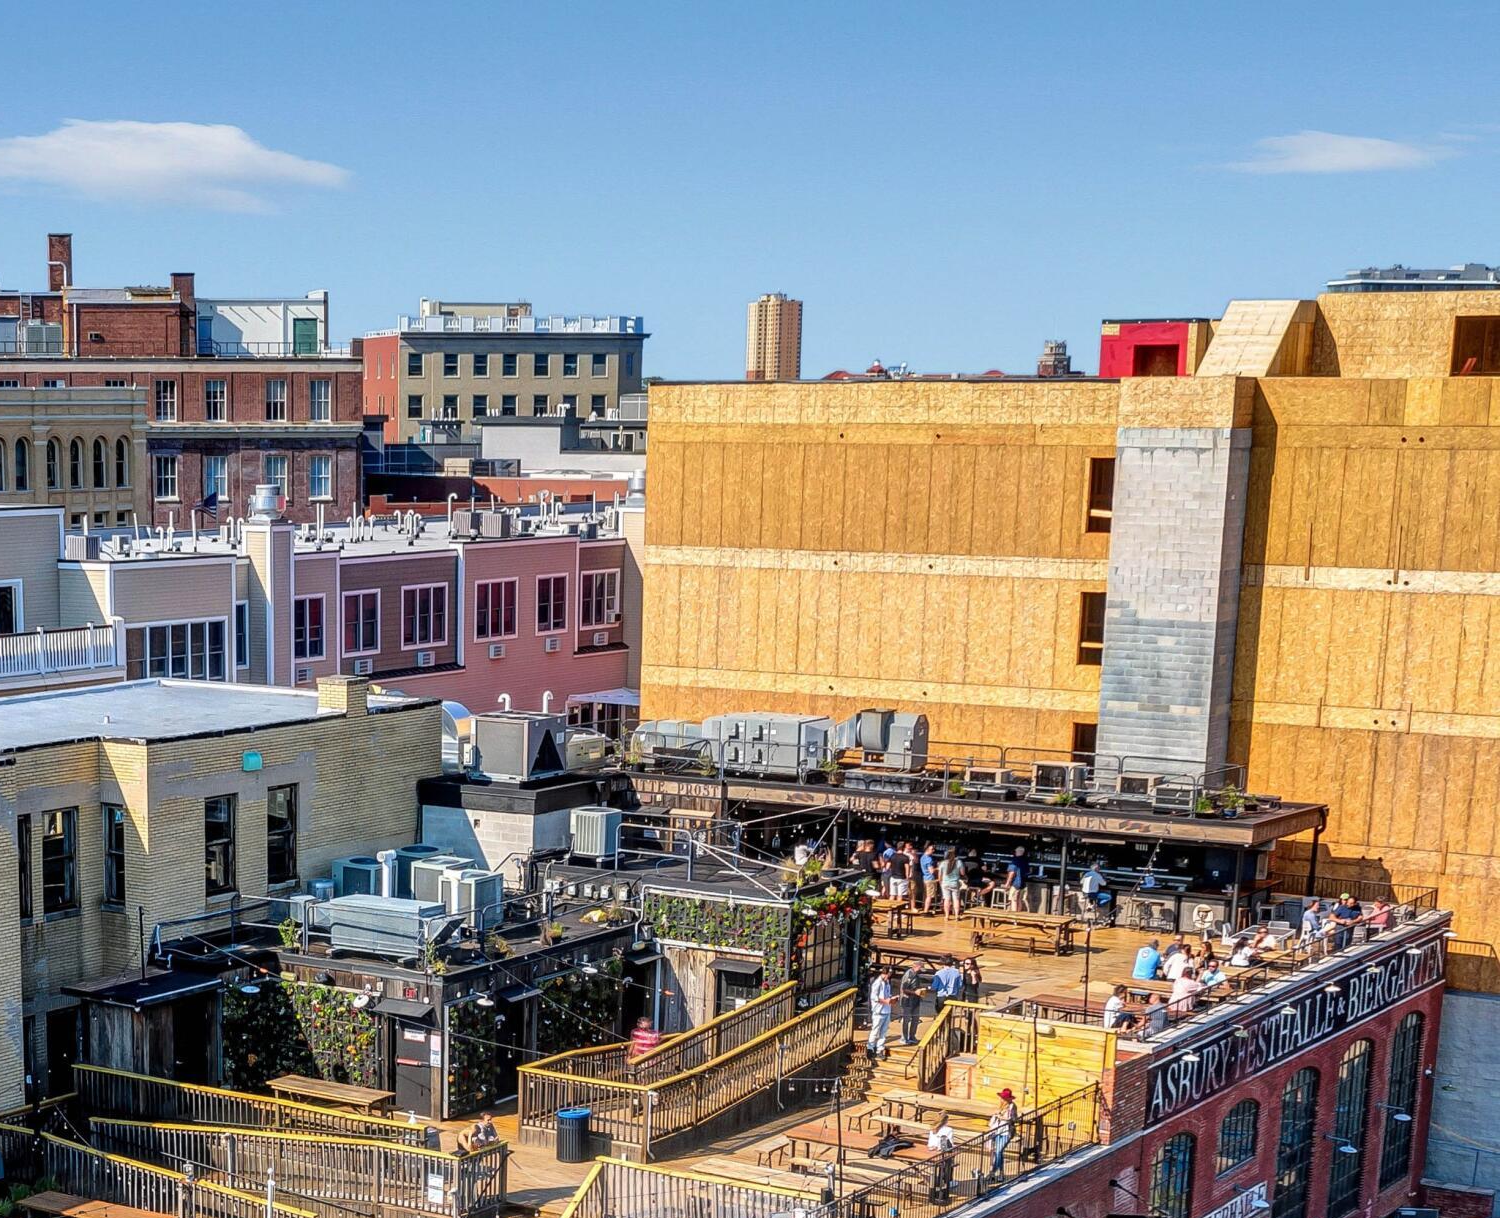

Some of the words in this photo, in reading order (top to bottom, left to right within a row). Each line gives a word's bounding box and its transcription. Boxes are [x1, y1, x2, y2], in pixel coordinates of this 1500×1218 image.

[1149, 1038, 1234, 1122] ASBURY
[1235, 993, 1336, 1079] FESTHALLE
[1346, 939, 1444, 1024] BIERGARTEN
